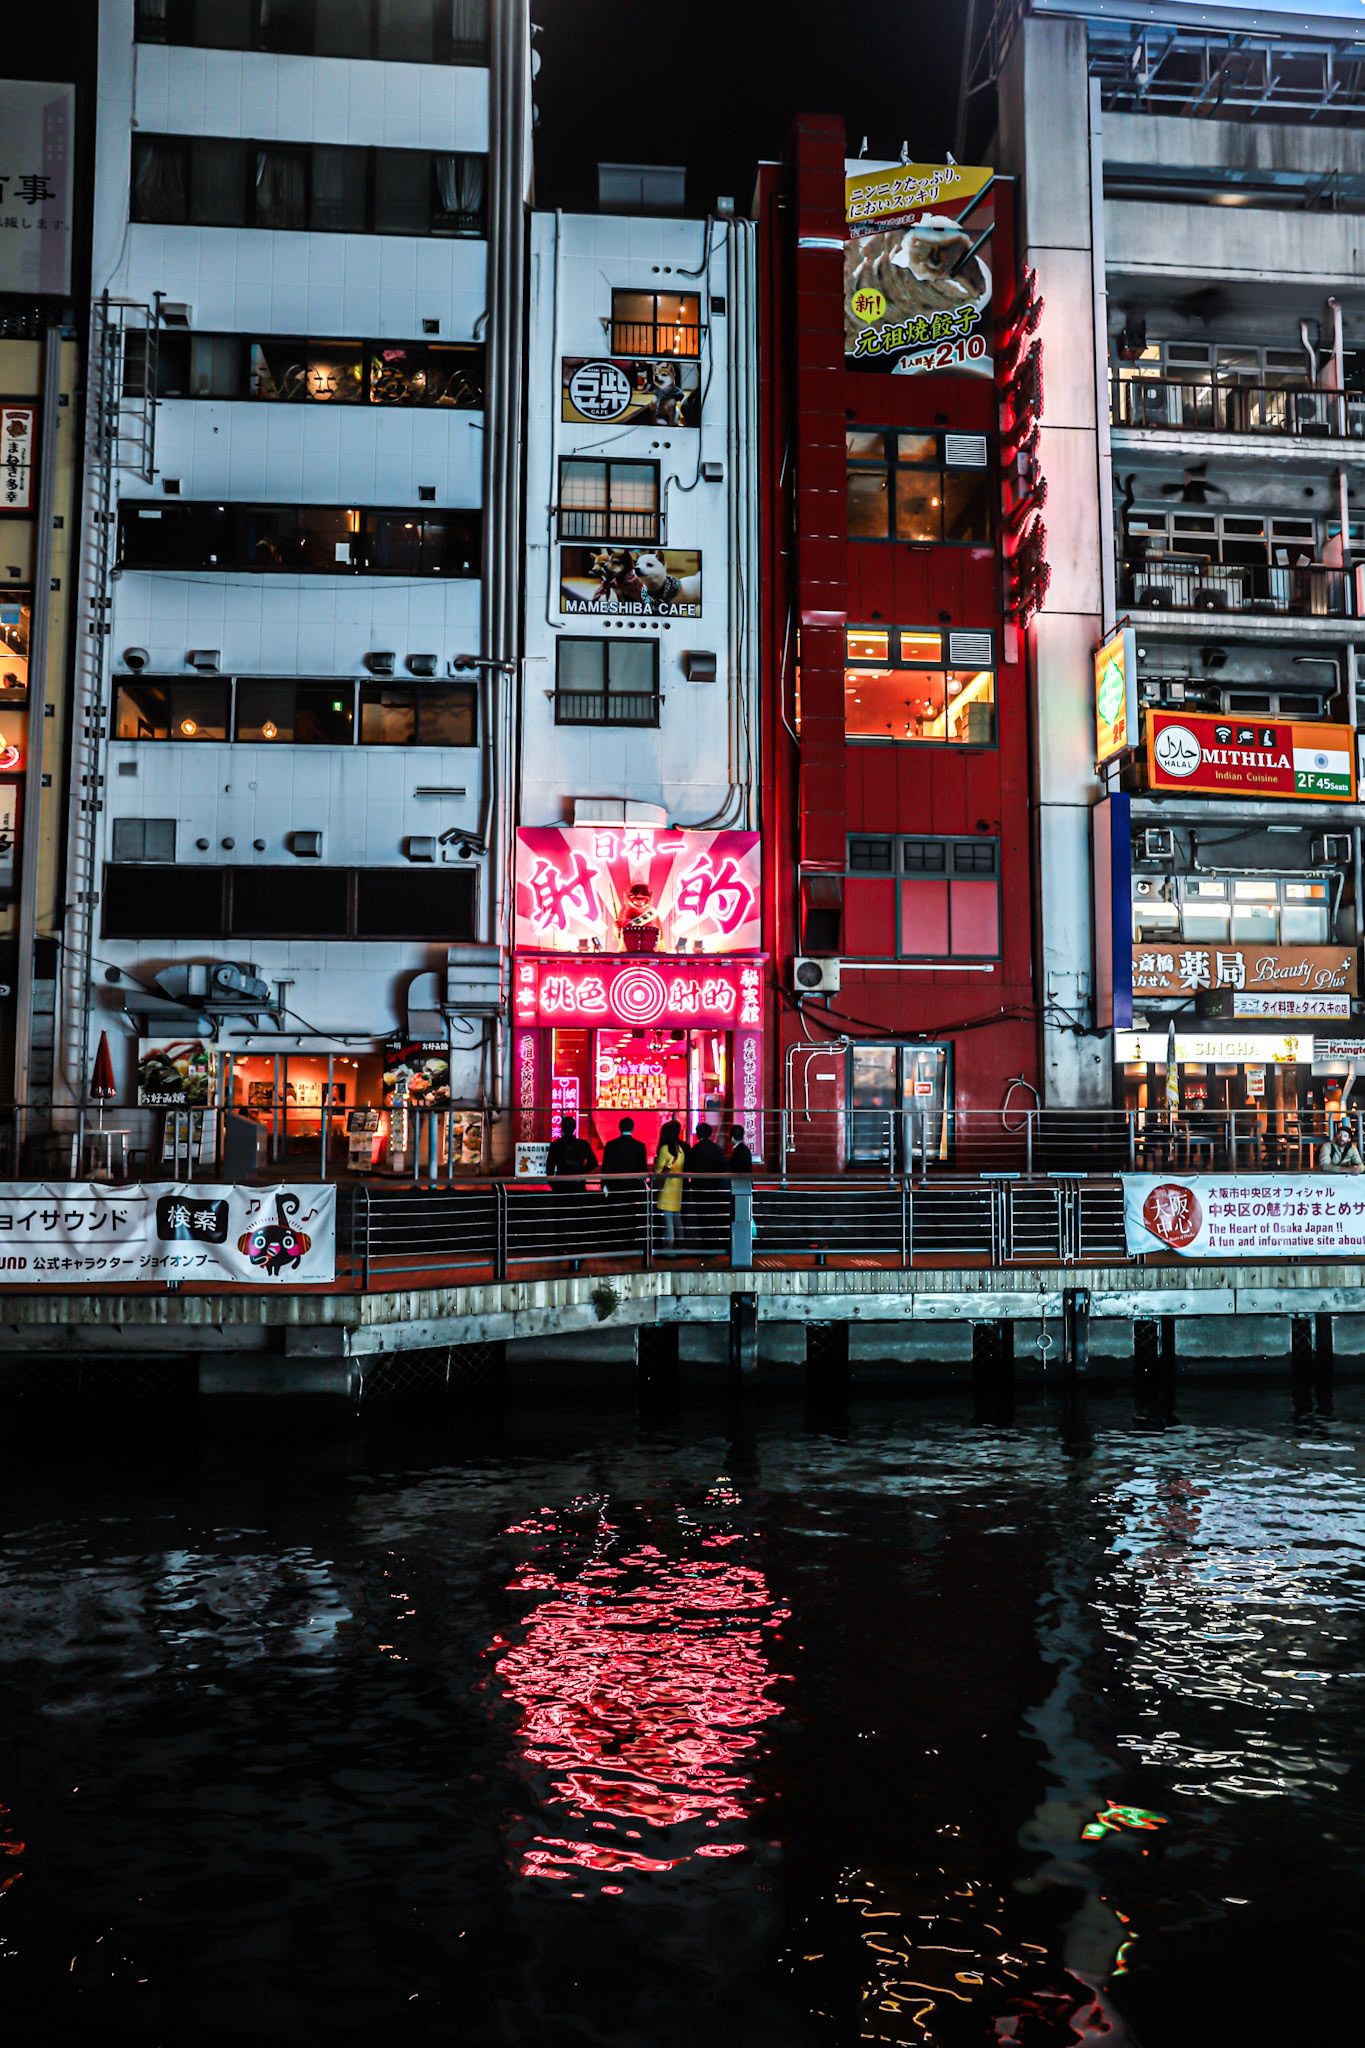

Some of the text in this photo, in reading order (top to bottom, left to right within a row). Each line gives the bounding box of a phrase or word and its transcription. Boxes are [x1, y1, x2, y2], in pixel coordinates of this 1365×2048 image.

[850, 168, 961, 202] ニンニクたっぷり、
[849, 186, 940, 219] においスッキリ
[855, 304, 981, 357] 元祖焼餃子
[572, 372, 629, 409] 豆柴
[566, 600, 696, 616] MAMESHIBA CAFE
[1113, 719, 1125, 745] 2F
[1159, 736, 1198, 759] حلال
[1201, 748, 1291, 769] MITHILA
[1164, 760, 1193, 769] HALAL
[1215, 770, 1279, 784] Indian Cuisine
[1297, 773, 1315, 788] 2F
[596, 831, 687, 861] 日本一
[1132, 953, 1175, 973] 斎橋
[1178, 950, 1247, 990] 薬局
[1250, 956, 1347, 990] Beauty Plus
[516, 966, 536, 1017] 日本一
[669, 978, 736, 1013] 射的
[740, 968, 760, 1024] 秘宝館
[1262, 1000, 1348, 1014] タイ料理とタイスキの店
[1195, 1042, 1259, 1056] SINGHA
[141, 1092, 186, 1104] お好み焼
[1208, 1187, 1335, 1199] 大阪市中央区オフィシャル
[167, 1204, 217, 1232] 検索
[1150, 1194, 1189, 1222] 大阪
[1208, 1202, 1365, 1217] 中央区の魅力おまとめサ
[1156, 1215, 1192, 1239] 中心
[1208, 1223, 1226, 1234] The
[1229, 1223, 1257, 1234] Heart
[1260, 1222, 1270, 1234] of
[1273, 1222, 1302, 1233] Osaka
[1305, 1222, 1334, 1235] Japan
[1209, 1236, 1216, 1247] A
[1219, 1236, 1235, 1247] fun
[1238, 1235, 1255, 1247] and
[1258, 1235, 1314, 1246] informative
[1317, 1235, 1335, 1246] site
[33, 1256, 133, 1270] 公式キャラクター
